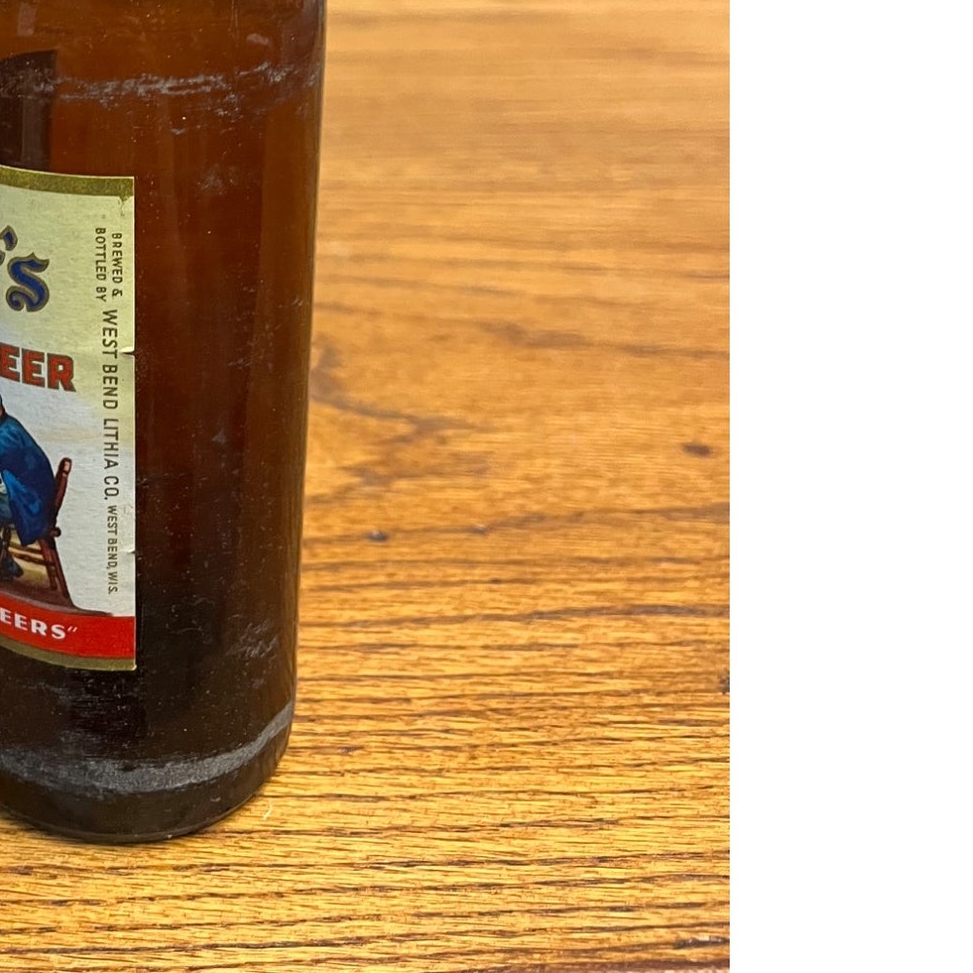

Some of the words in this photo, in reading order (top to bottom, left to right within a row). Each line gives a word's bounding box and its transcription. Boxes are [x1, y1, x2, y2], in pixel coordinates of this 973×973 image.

[95, 227, 107, 281] BOTTLED
[111, 232, 123, 284] BREWED
[96, 286, 107, 302] BY
[112, 289, 123, 298] &
[102, 309, 118, 359] WEST
[103, 365, 119, 409] BEND
[103, 418, 120, 470] LITHIA
[104, 476, 120, 501] CO.
[107, 505, 118, 535] WEST
